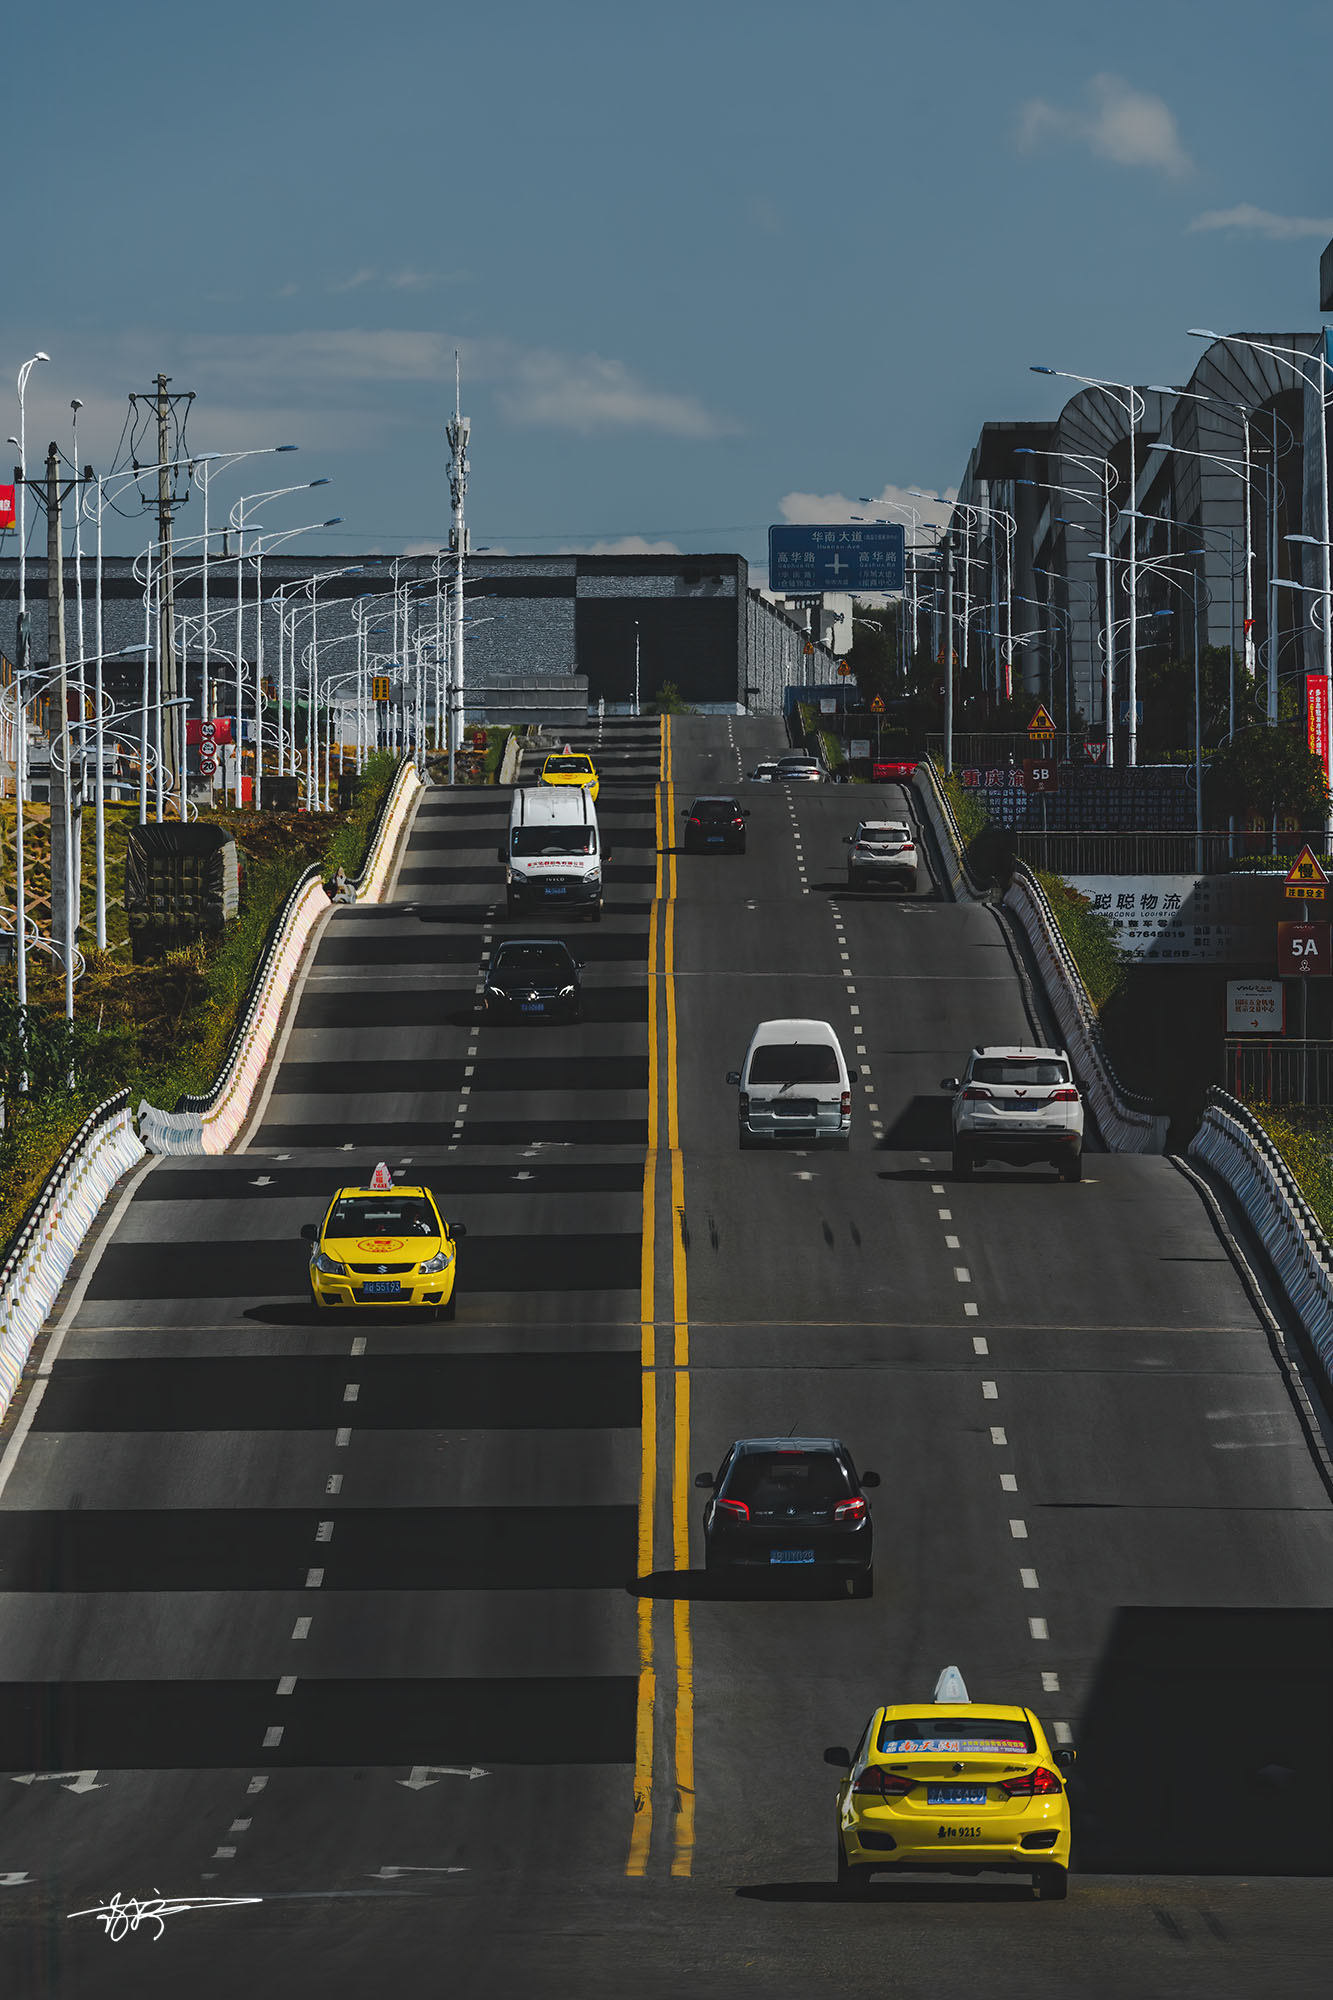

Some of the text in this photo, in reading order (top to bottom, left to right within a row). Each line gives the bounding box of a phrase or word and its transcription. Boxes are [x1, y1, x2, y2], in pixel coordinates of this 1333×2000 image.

[811, 530, 863, 543] 华南大道
[777, 551, 816, 563] 高华路
[859, 551, 897, 563] 高华路
[1032, 768, 1050, 780] 5B
[1298, 863, 1314, 878] 慢
[1093, 893, 1183, 910] 聪聪物流
[1291, 938, 1319, 957] 5A
[958, 1826, 982, 1837] 9215
